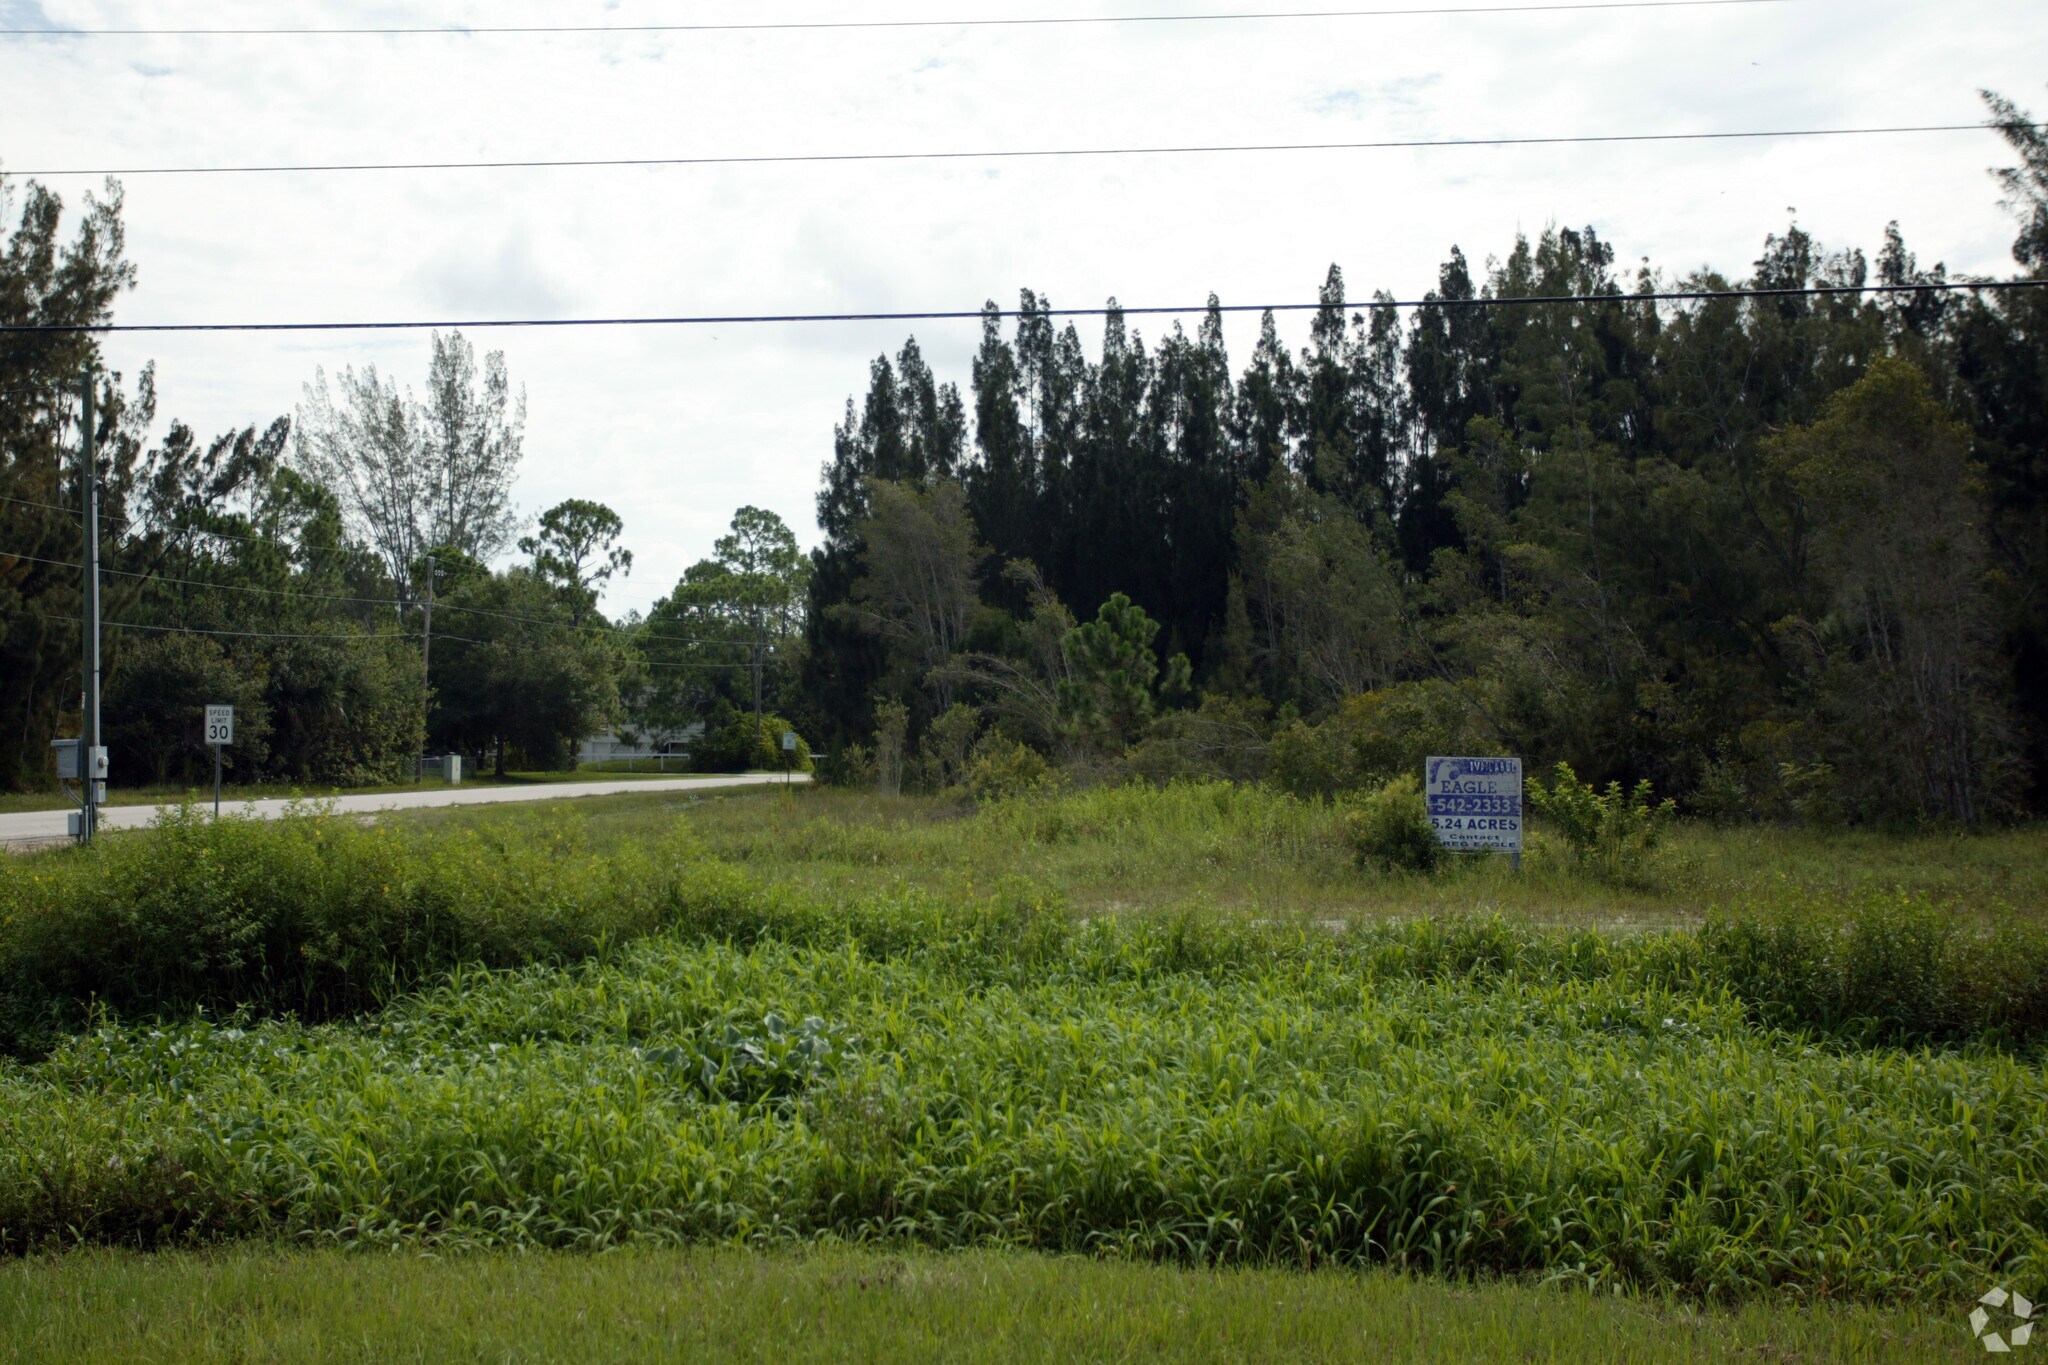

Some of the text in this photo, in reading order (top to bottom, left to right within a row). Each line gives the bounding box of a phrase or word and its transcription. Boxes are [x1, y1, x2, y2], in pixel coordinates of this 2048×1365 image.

[209, 709, 230, 717] SPEED
[209, 724, 228, 740] 30
[1441, 780, 1497, 794] EAGLE
[1437, 798, 1511, 813] 542-2333
[1432, 818, 1518, 831] 5.24 ACRES
[1449, 833, 1500, 841] Contact
[1474, 841, 1517, 849] EAGLE
